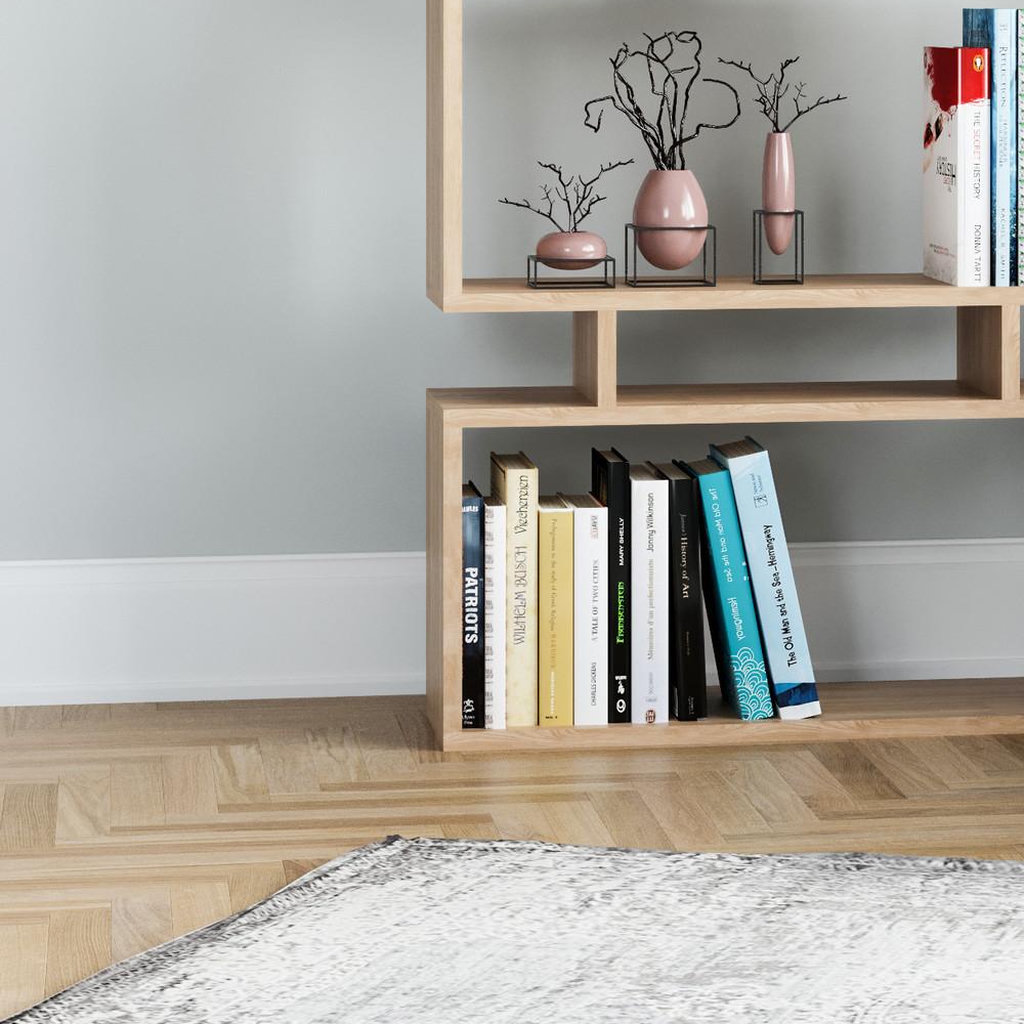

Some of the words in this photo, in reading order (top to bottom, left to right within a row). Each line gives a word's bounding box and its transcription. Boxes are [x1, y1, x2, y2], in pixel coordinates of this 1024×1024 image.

[515, 475, 528, 534] Viechereien
[647, 530, 656, 552] Jonny
[515, 546, 527, 587] BUSCH
[682, 570, 689, 581] of
[775, 588, 784, 602] the
[465, 567, 479, 644] PATRIOTS
[592, 606, 599, 615] OF
[776, 603, 788, 617] and
[514, 591, 526, 645] WILHELM
[781, 618, 791, 634] Man
[783, 636, 794, 651] Old
[786, 652, 797, 667] The
